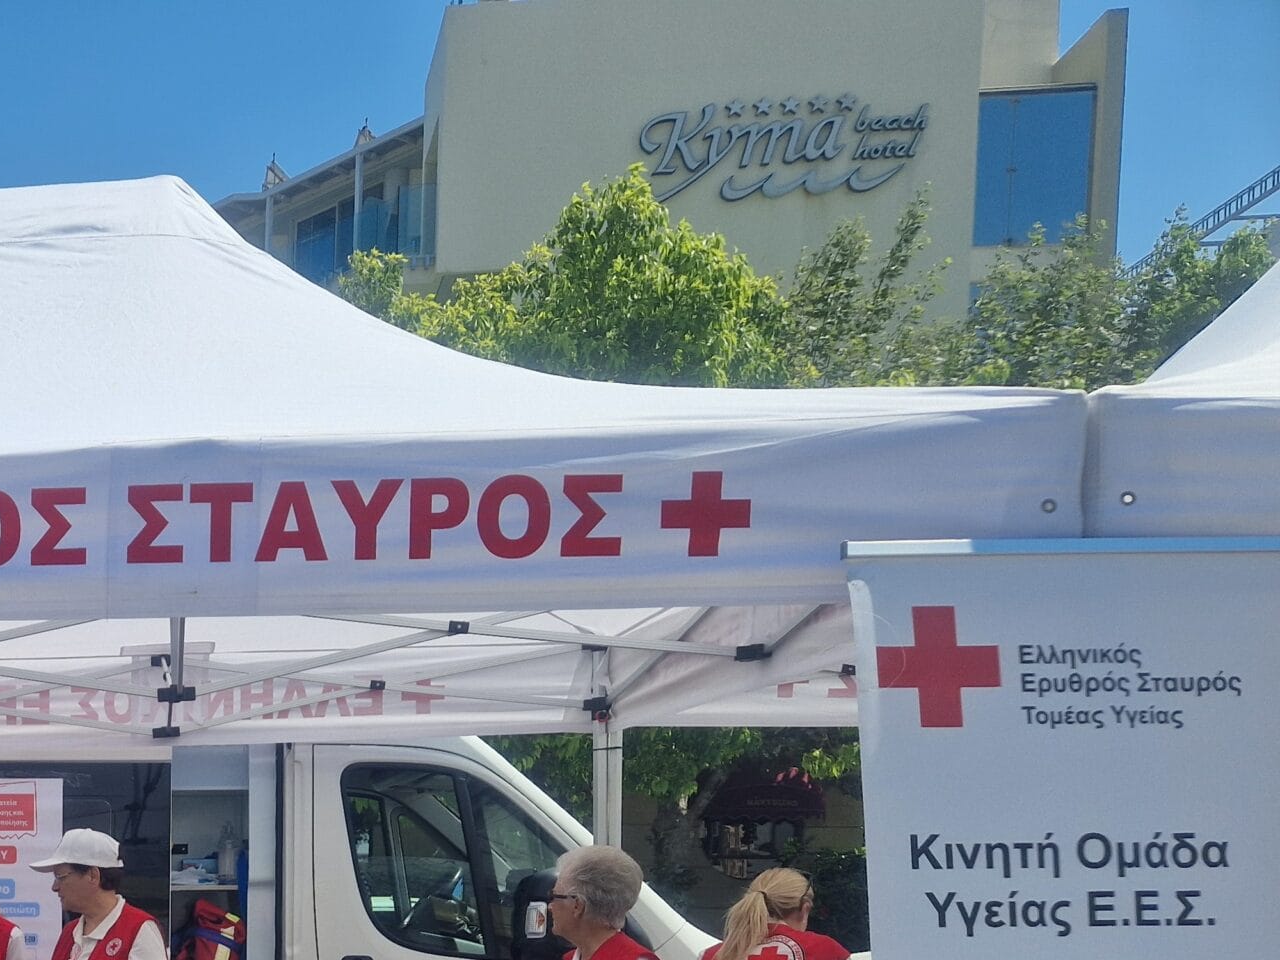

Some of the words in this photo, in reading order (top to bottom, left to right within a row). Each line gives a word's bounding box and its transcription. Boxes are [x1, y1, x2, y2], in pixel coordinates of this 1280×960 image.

[855, 102, 930, 133] beach
[639, 103, 848, 202] Kyma
[852, 133, 923, 161] hotel
[126, 474, 624, 563] ΣΤΑΥΡΟΣ
[1018, 643, 1142, 669] Ελληνικός
[1020, 671, 1131, 696] Ερυθρός
[1136, 672, 1242, 696] Σταυρός
[1021, 705, 1105, 729] Τομέας
[1110, 704, 1184, 729] Υγείας
[909, 832, 1061, 879] Κινητή
[1076, 831, 1230, 878] Ομάδα
[925, 890, 1072, 938] Υγείας
[1087, 890, 1217, 927] Ε.Ε.Σ.
